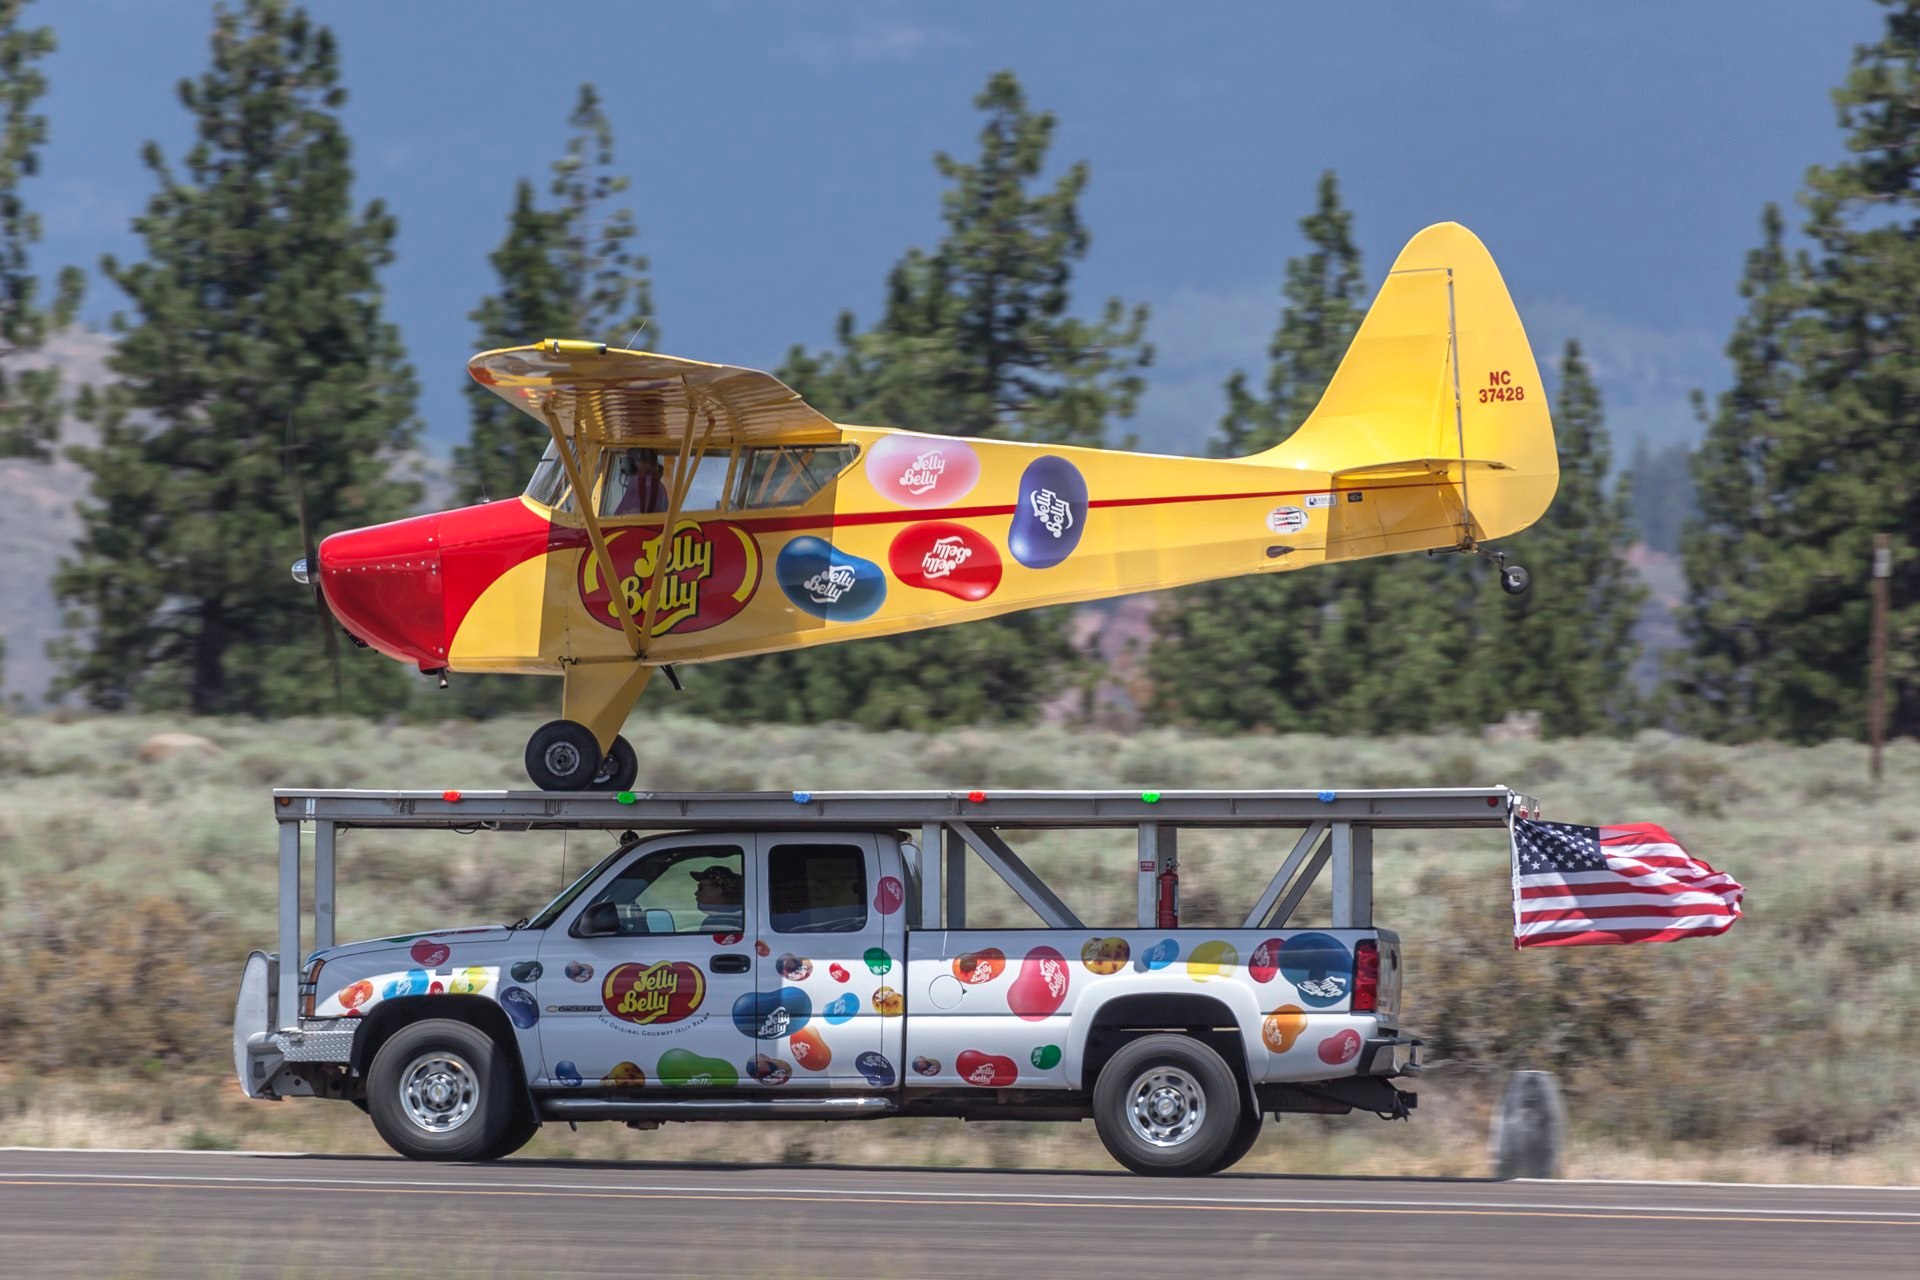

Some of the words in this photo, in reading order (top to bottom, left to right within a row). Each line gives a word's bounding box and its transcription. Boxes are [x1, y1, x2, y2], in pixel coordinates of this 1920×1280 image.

[1489, 370, 1511, 386] NC
[1479, 386, 1525, 403] 37428
[912, 449, 945, 475] Jelly
[899, 468, 937, 495] Belly
[1030, 488, 1057, 523] Jelly
[1045, 498, 1073, 538] Belly
[932, 536, 972, 564] Belly
[821, 565, 856, 592] Jelly
[921, 552, 957, 579] Jelly
[803, 575, 843, 603] Belly
[633, 960, 678, 995] Jelly
[1040, 959, 1060, 982] Jelly
[1048, 971, 1066, 998] Belly
[617, 990, 670, 1024] Belly
[765, 1006, 790, 1026] Jelly
[609, 1022, 640, 1035] ORIGINAL
[675, 1025, 691, 1034] JELLY
[758, 1024, 787, 1039] Belly
[968, 1073, 992, 1086] Belly
[975, 1063, 996, 1078] Jelly
